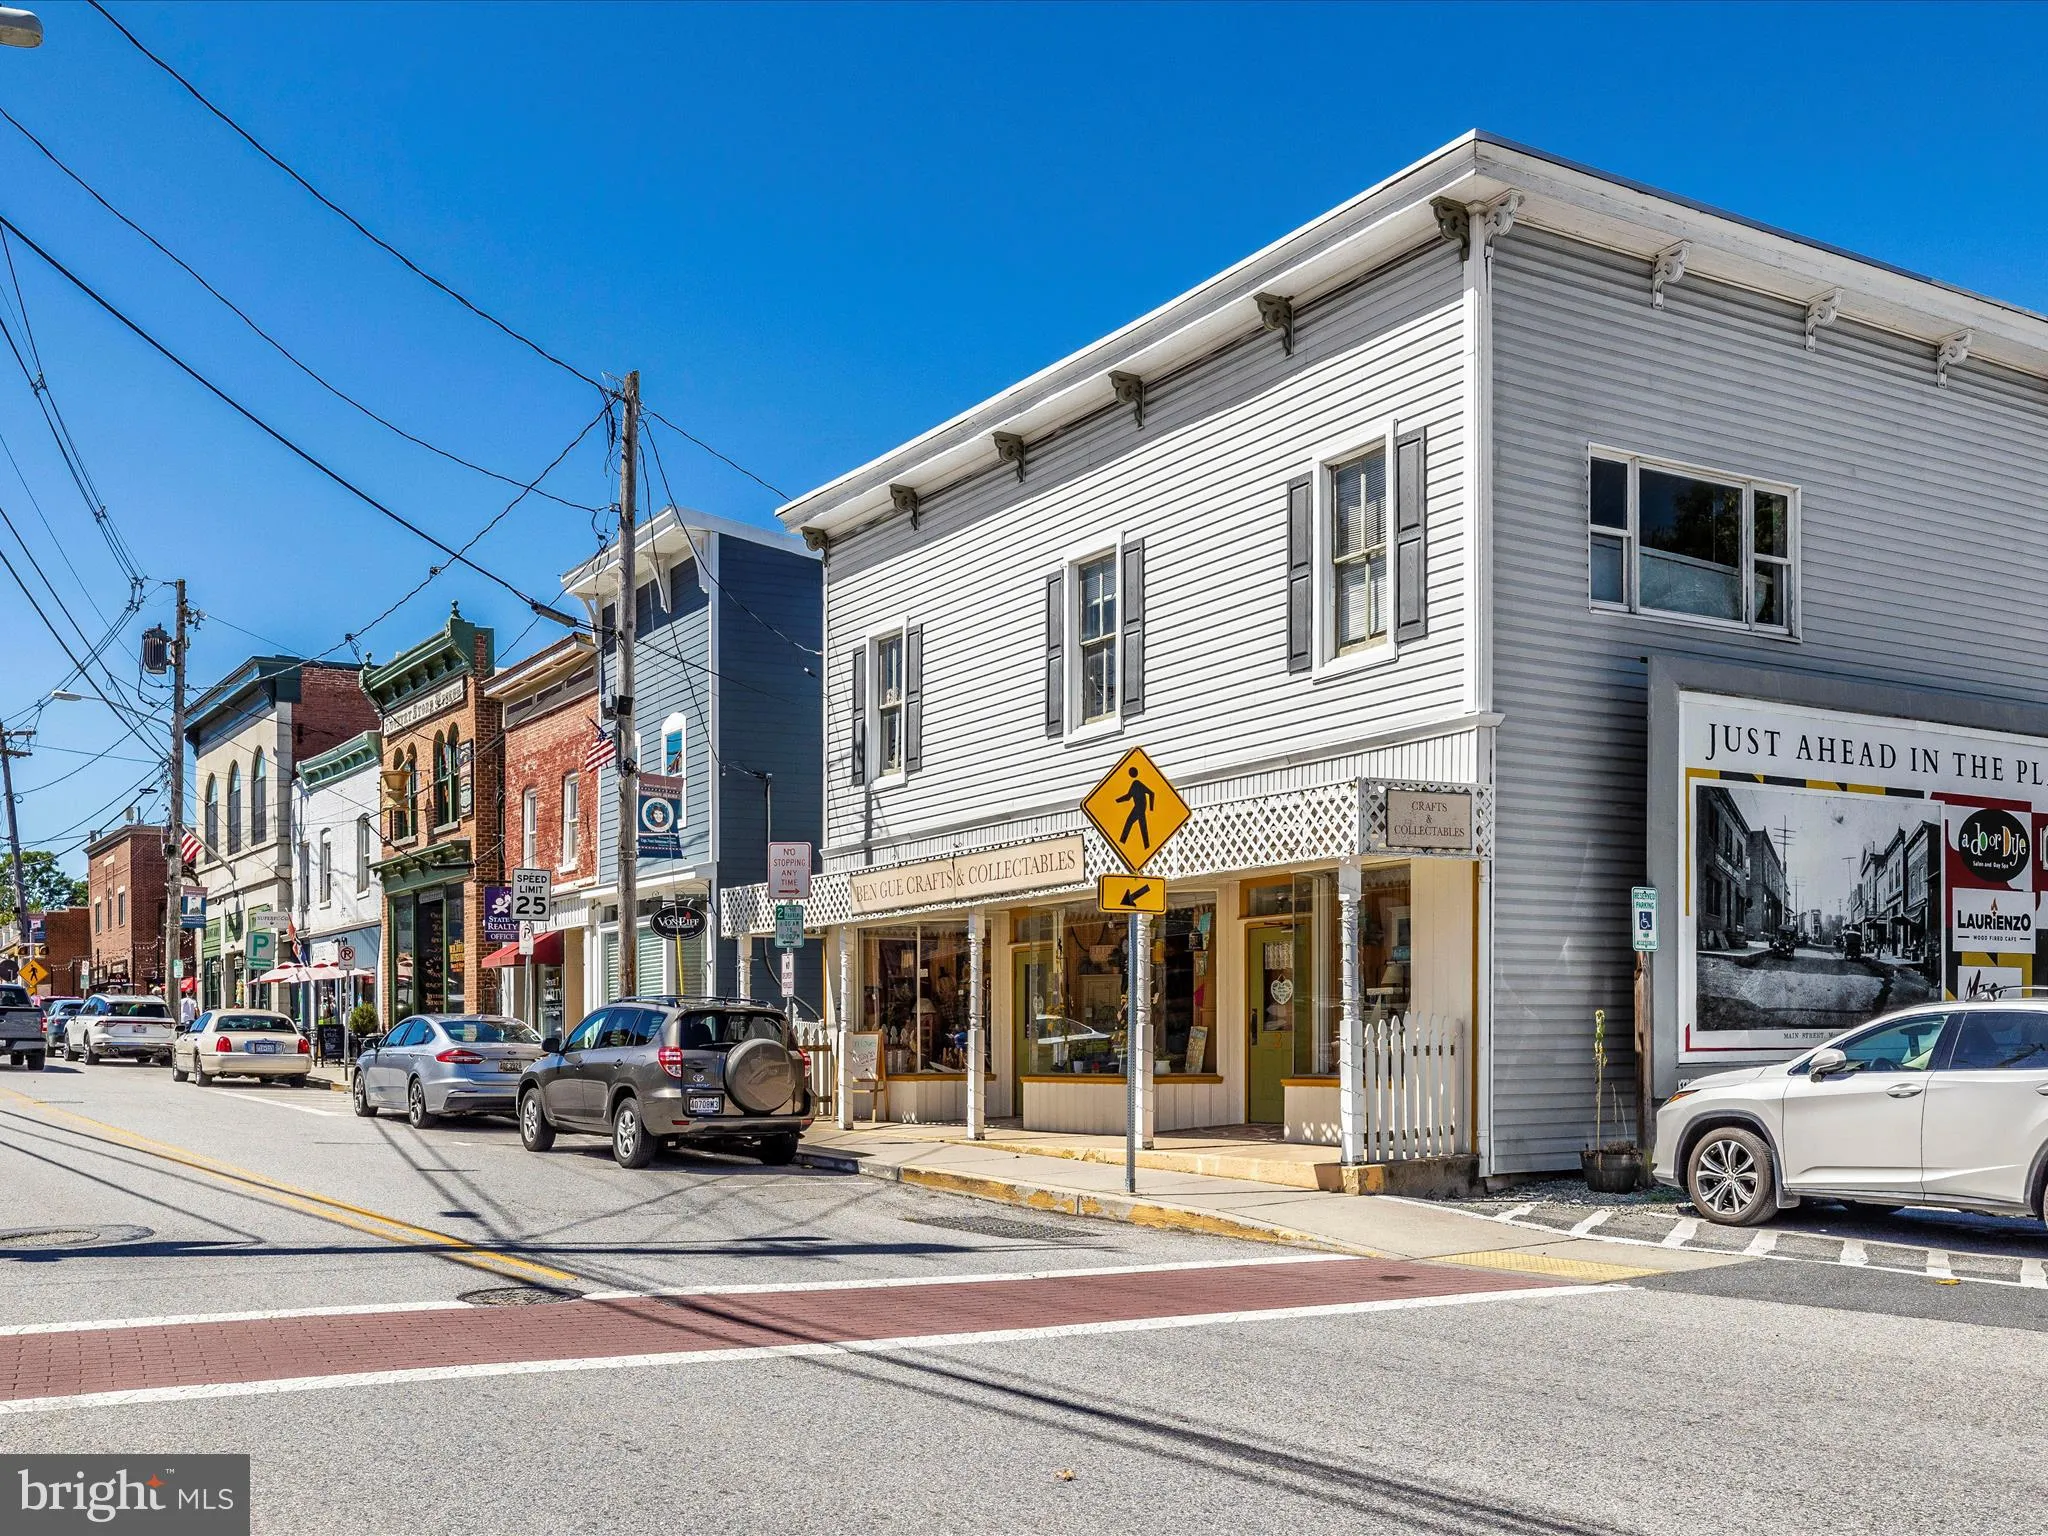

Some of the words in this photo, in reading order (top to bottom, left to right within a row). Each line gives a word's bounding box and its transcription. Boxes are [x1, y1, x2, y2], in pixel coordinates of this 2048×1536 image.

[1705, 723, 1781, 761] JUST
[1796, 734, 1897, 769] AHEAD
[1910, 747, 1940, 774] IN
[1952, 752, 2004, 781] THE
[2016, 759, 2048, 786] PL
[1411, 800, 1448, 813] CRAFTS
[1425, 814, 1433, 824] &
[1394, 824, 1465, 837] COLLECTABLES
[783, 847, 796, 856] NO
[773, 859, 806, 867] STOPPING
[517, 875, 548, 884] SPEED
[879, 879, 904, 899] GUE
[906, 871, 954, 895] CRAFTS
[956, 873, 965, 887] &
[968, 850, 1076, 884] COLLECTABLES
[520, 886, 543, 894] LIMIT
[516, 896, 546, 915] 25
[777, 907, 784, 918] 2
[487, 923, 518, 931] REALTY
[1783, 1032, 1800, 1040] MAIN
